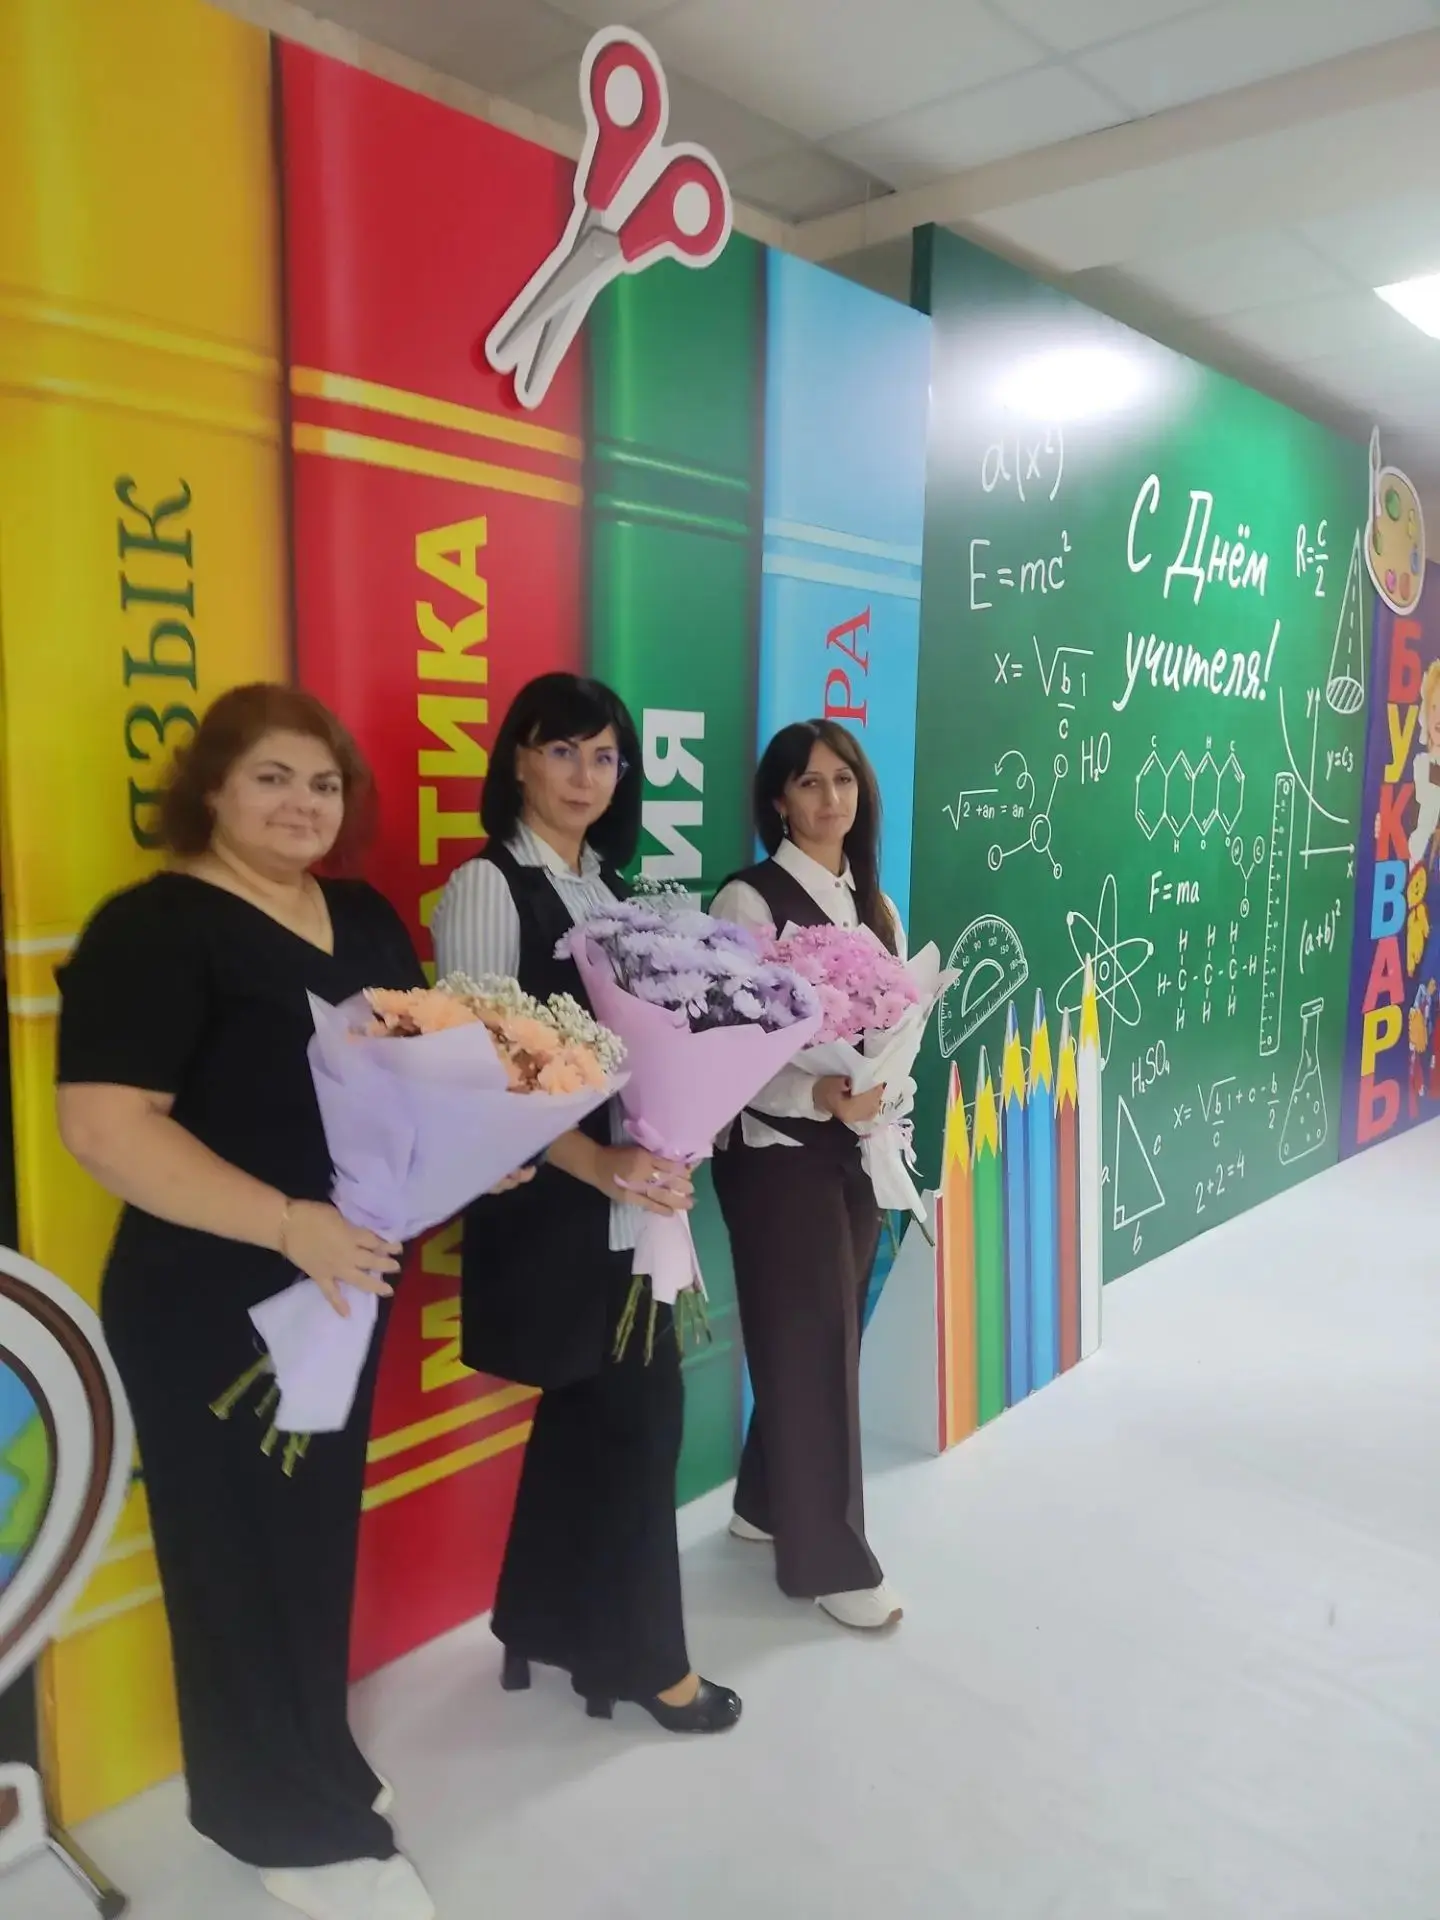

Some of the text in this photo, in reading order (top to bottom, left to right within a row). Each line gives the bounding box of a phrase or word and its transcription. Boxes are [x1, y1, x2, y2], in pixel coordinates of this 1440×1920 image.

[1126, 474, 1270, 605] С Днём
[1112, 618, 1281, 712] учителя!
[1357, 618, 1422, 1143] БУКВАРЬ
